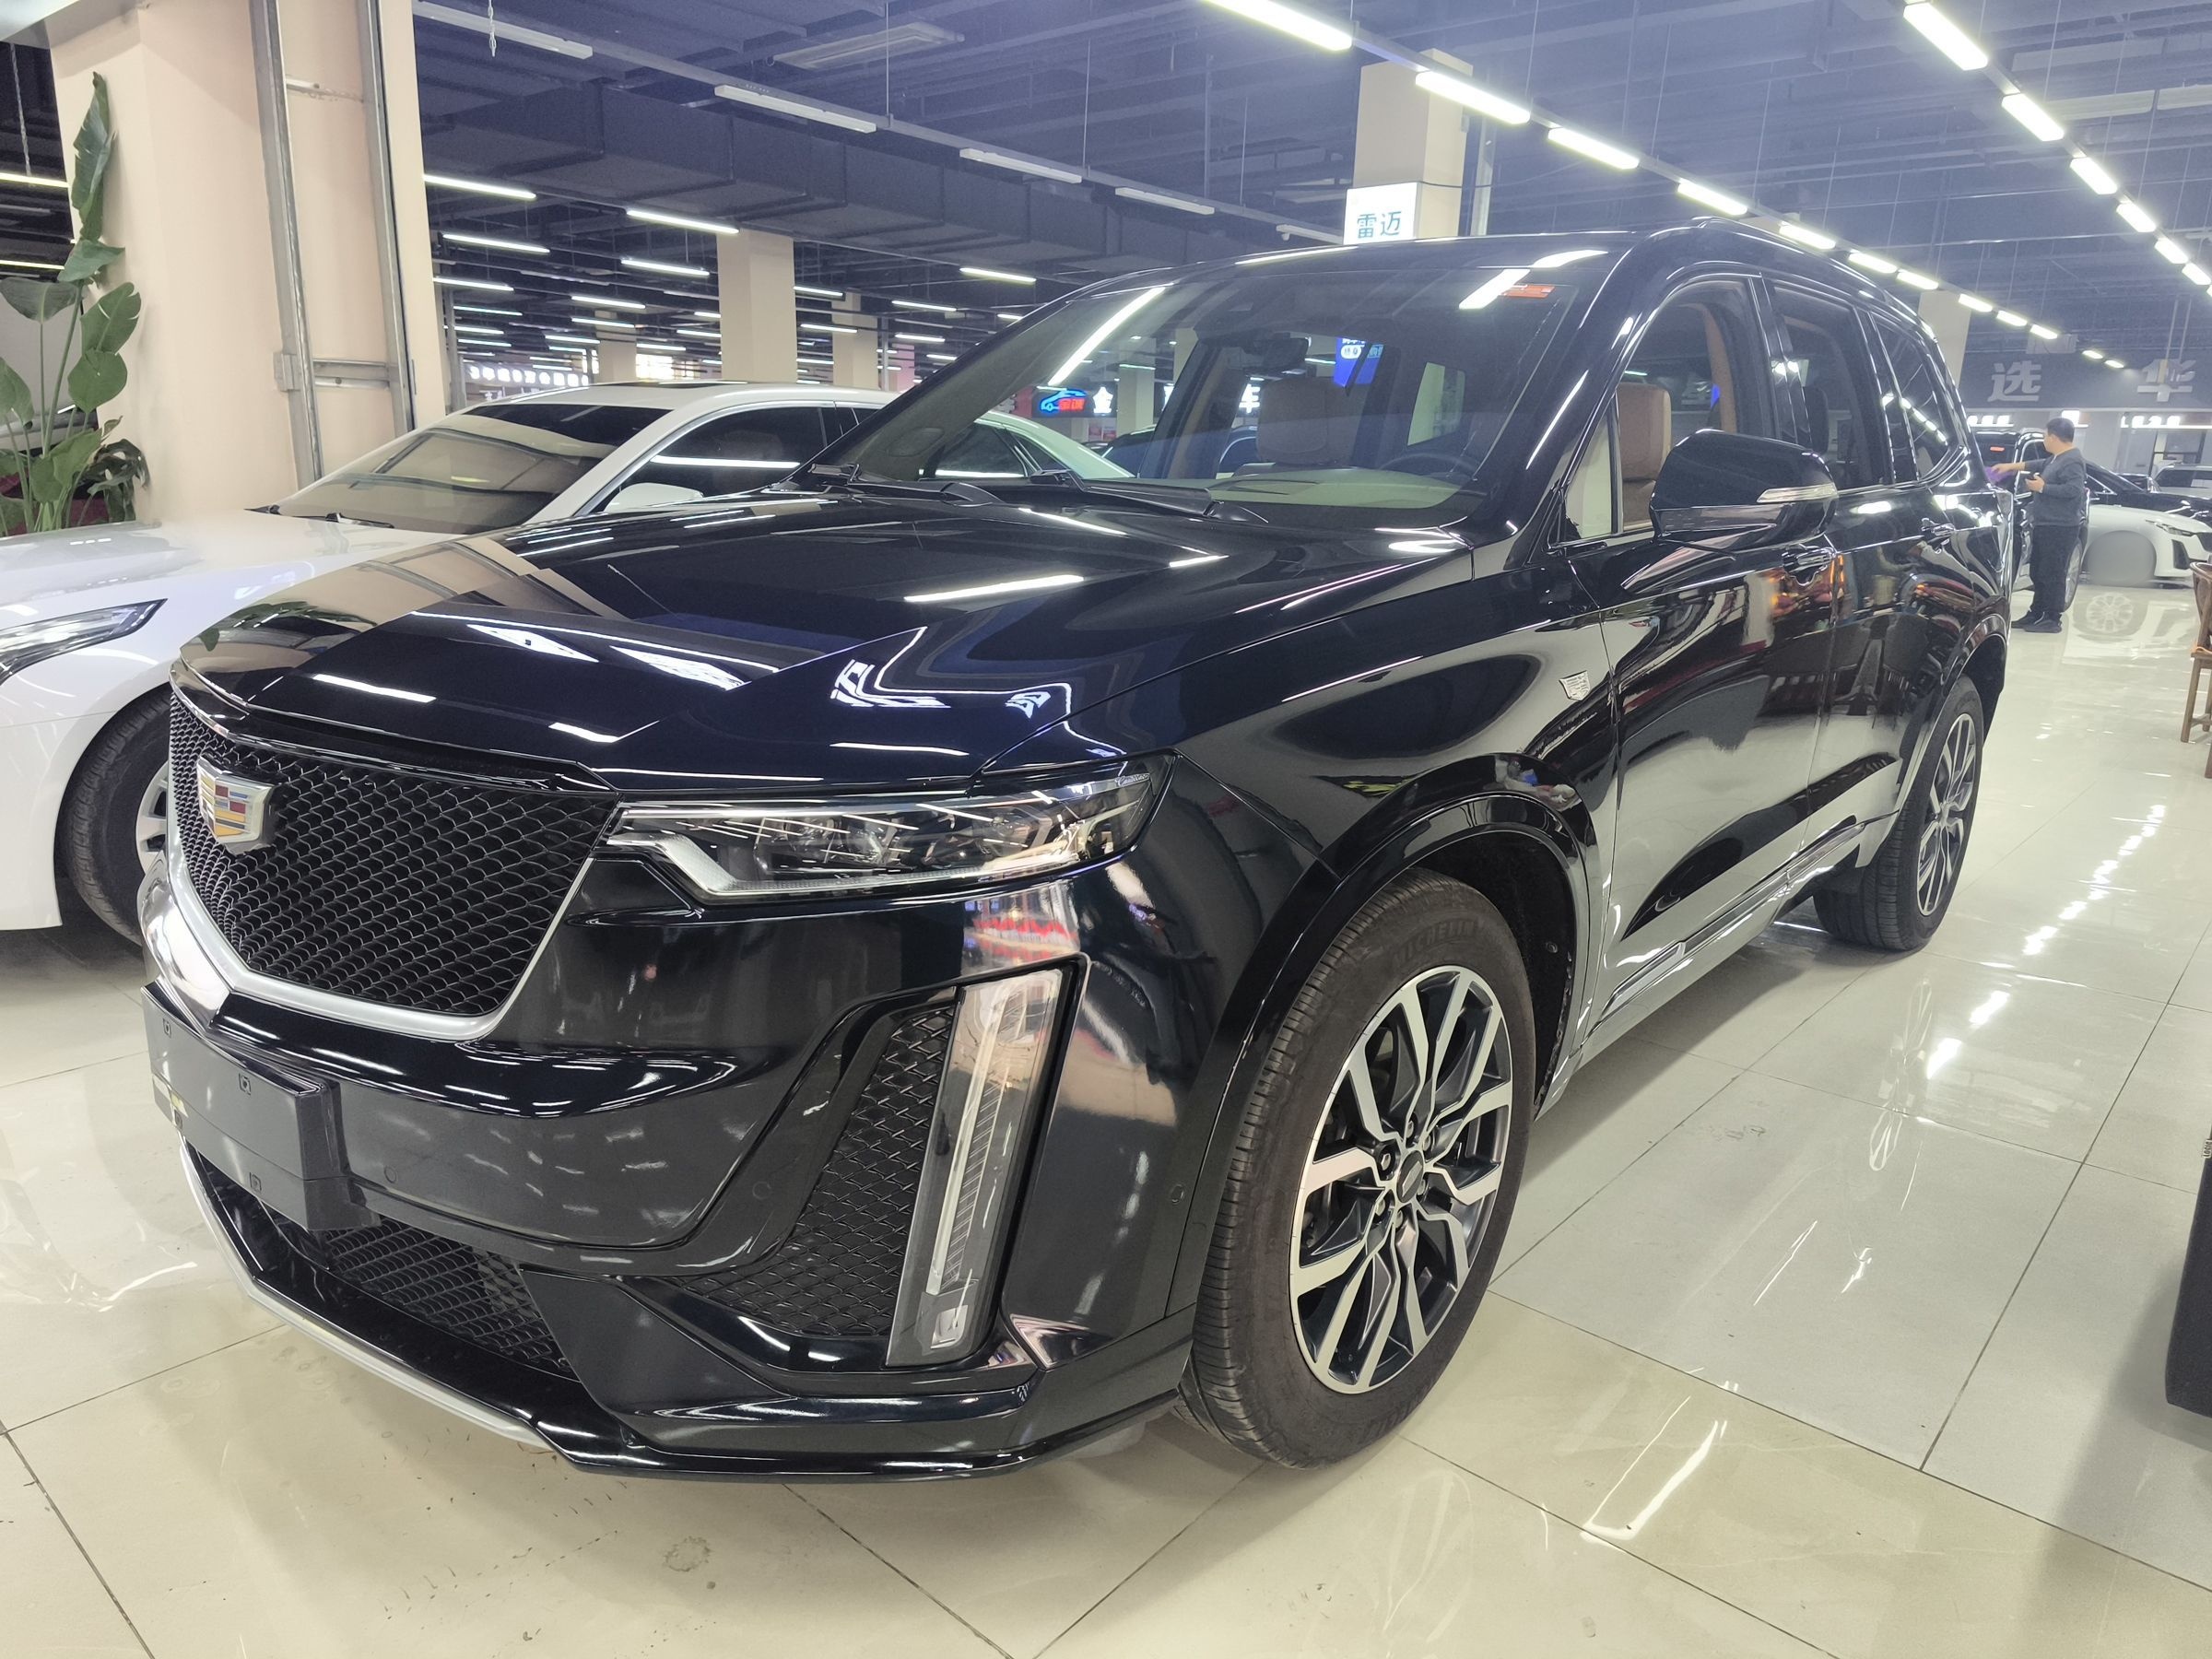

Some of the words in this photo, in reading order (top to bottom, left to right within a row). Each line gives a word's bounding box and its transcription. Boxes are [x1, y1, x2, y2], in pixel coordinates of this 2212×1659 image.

[1357, 210, 1402, 239] 雷迈
[1114, 773, 1148, 788] Cadillac
[1392, 919, 1477, 968] MICHELIN
